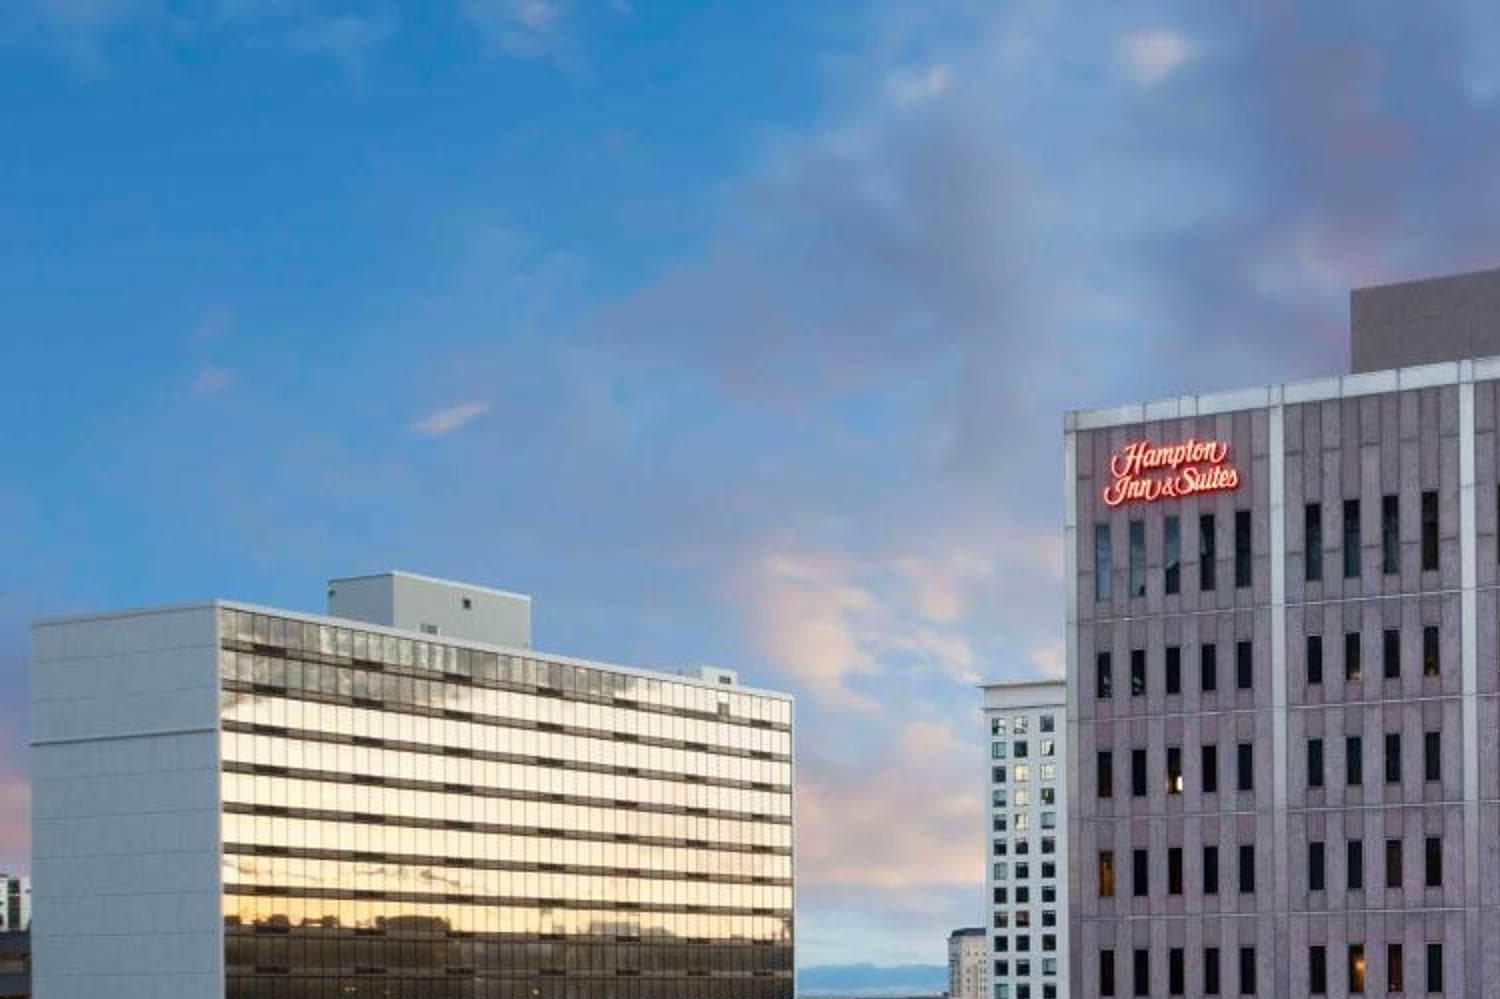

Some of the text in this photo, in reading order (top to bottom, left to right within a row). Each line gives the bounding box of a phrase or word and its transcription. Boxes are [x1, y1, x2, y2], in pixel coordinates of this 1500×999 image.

[1111, 438, 1227, 478] Hampton
[1103, 466, 1239, 505] Inn & Suites
